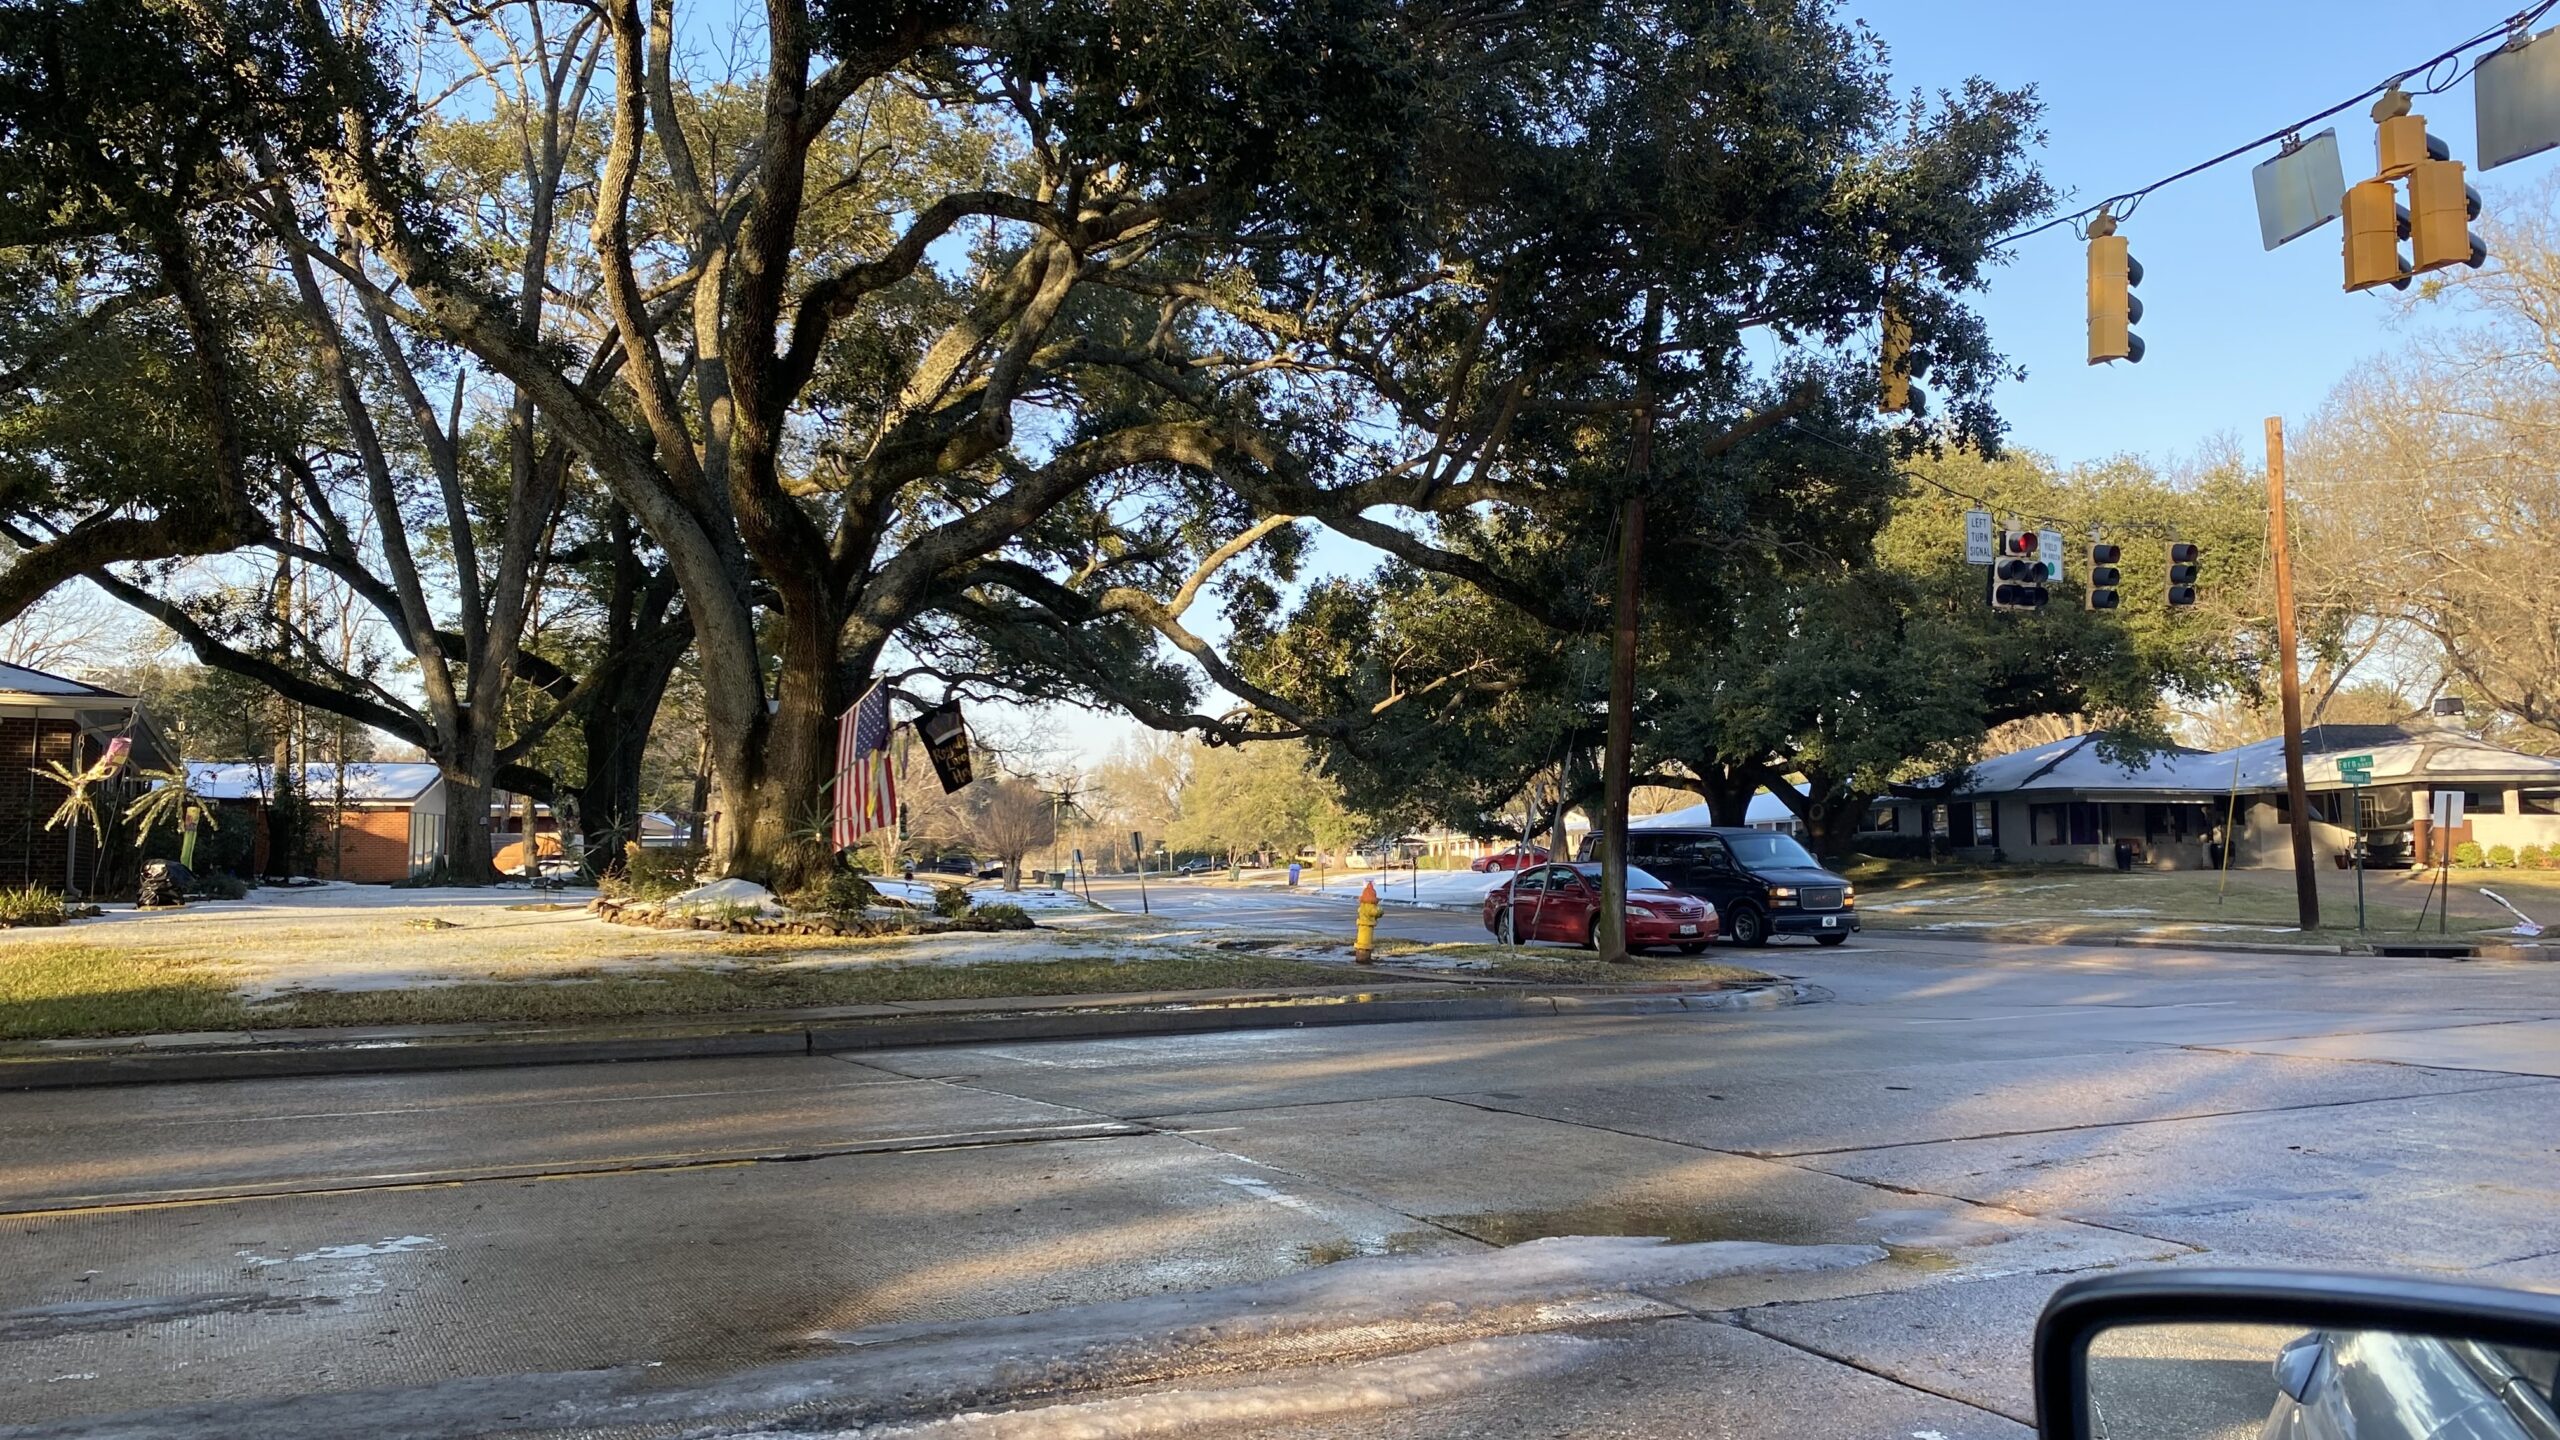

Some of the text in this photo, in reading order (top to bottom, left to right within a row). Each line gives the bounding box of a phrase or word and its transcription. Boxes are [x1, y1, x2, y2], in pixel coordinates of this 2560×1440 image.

[1971, 518, 1986, 528] LEFT
[1971, 532, 1988, 542] TURN
[1970, 546, 1991, 557] SIGNAL
